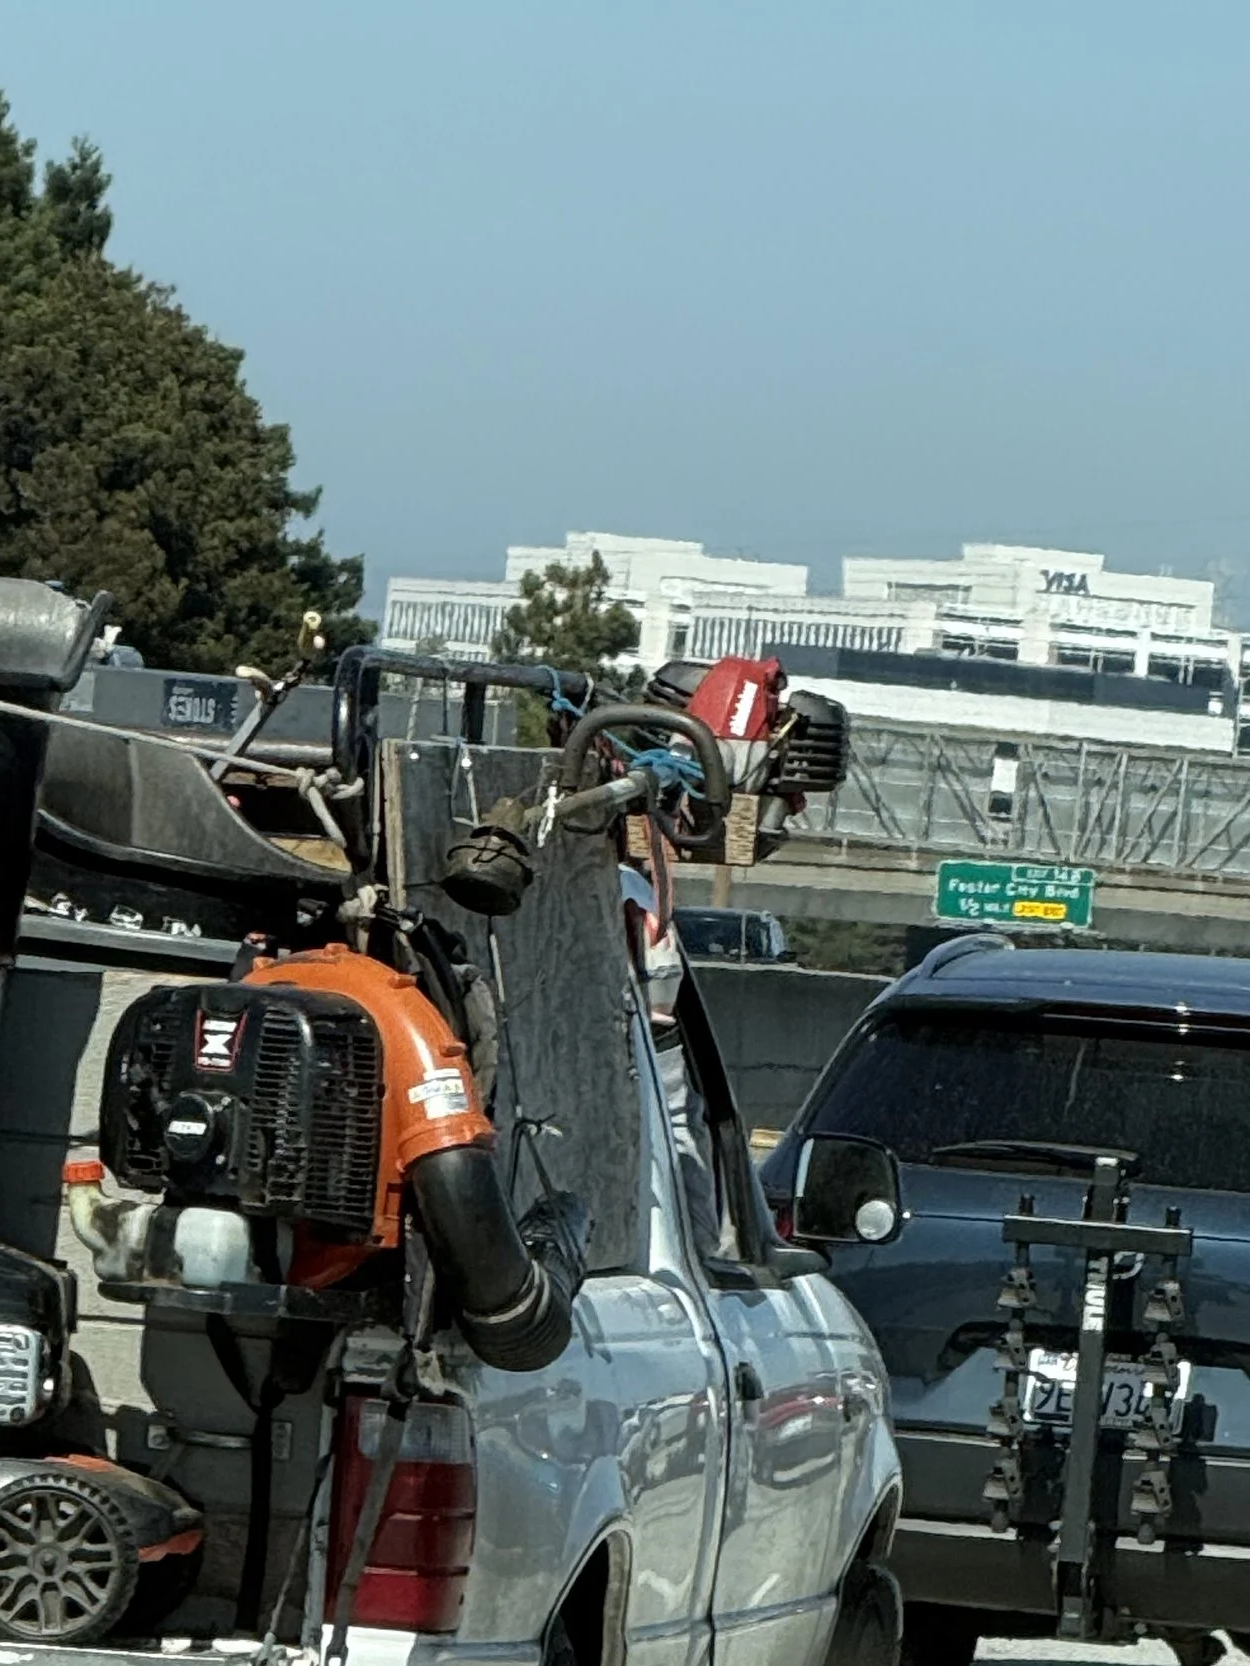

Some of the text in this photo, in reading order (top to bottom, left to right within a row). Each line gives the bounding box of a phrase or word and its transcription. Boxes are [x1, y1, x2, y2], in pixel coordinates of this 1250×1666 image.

[1039, 569, 1090, 597] VISA
[948, 878, 1080, 899] Foster City Blvd
[1082, 1256, 1108, 1332] THULE
